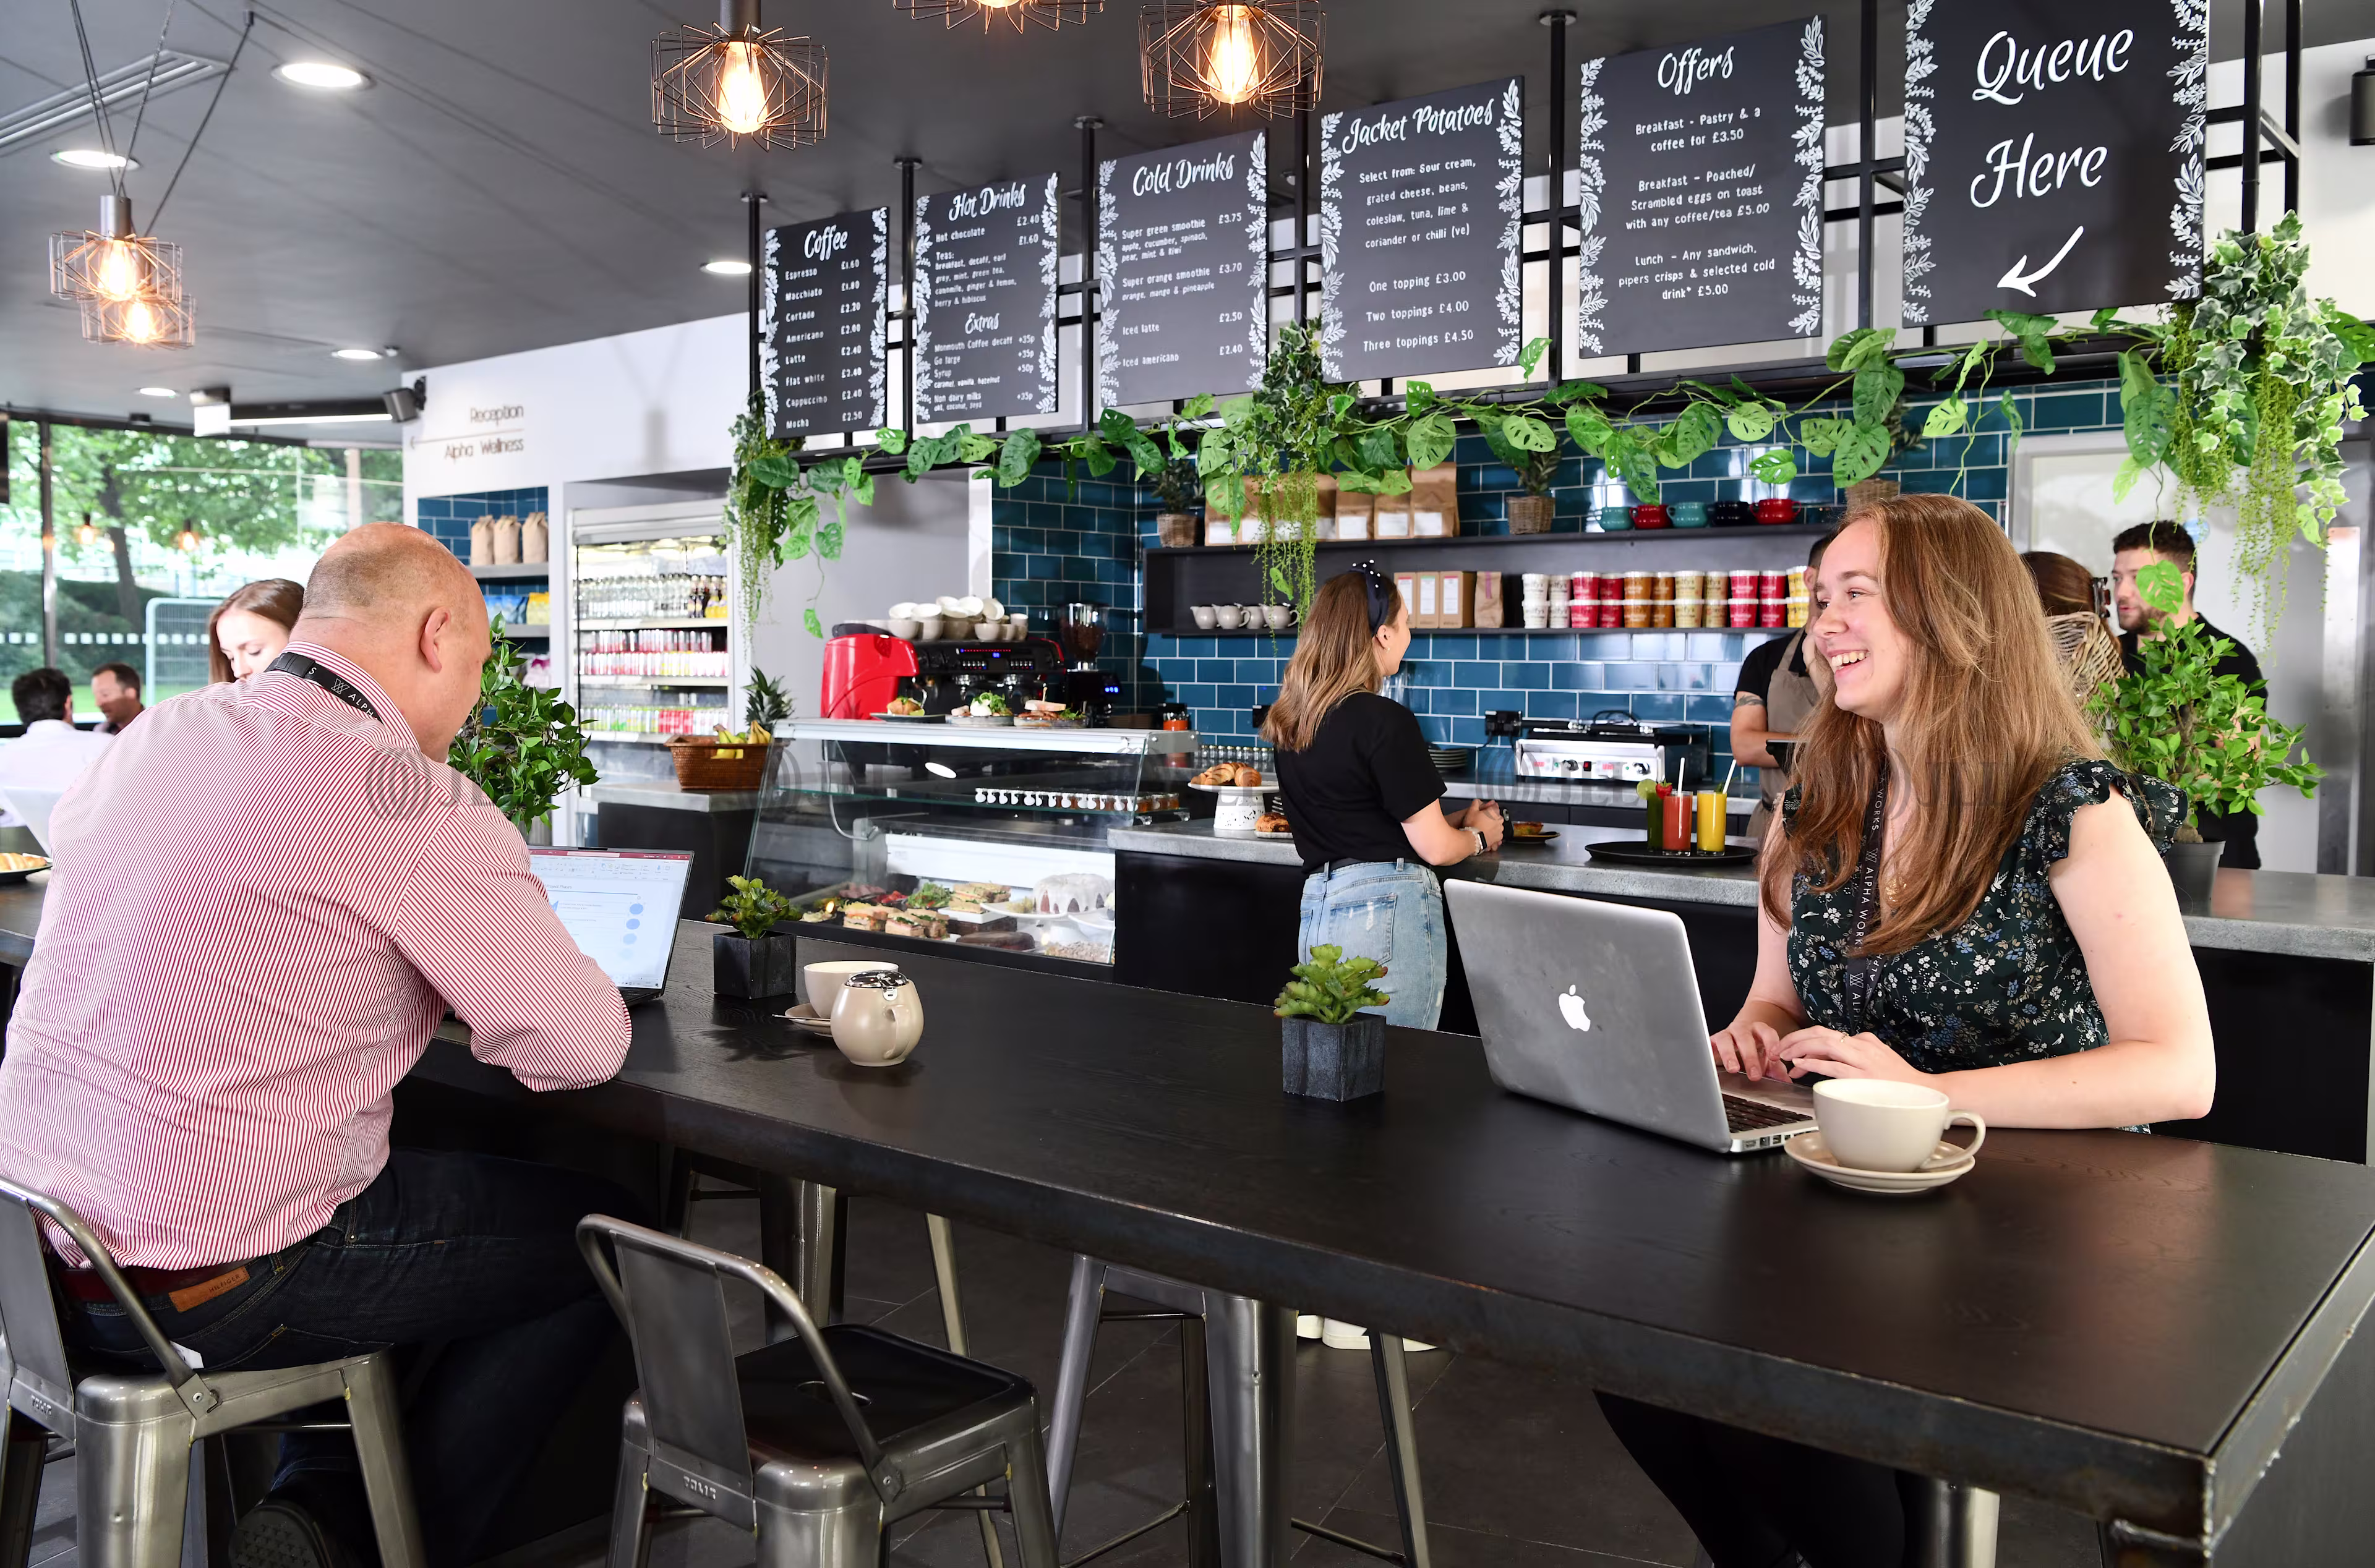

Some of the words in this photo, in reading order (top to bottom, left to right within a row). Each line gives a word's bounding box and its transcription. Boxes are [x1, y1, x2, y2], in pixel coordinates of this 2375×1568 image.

[1658, 46, 1734, 95] Offers
[1972, 30, 2133, 105] Queue
[1342, 114, 1407, 153] Jacket
[1413, 98, 1494, 135] Potatoes
[1636, 119, 1684, 135] Breakfast
[1700, 113, 1733, 125] Pastry
[1740, 108, 1748, 119] &
[1755, 108, 1760, 117] a
[1651, 139, 1684, 151] coffee
[1691, 136, 1705, 146] for
[1713, 129, 1744, 143] £3.50
[1133, 163, 1171, 196] Cold
[1176, 153, 1235, 189] Drinks
[1359, 171, 1387, 183] Select
[1392, 168, 1415, 178] from:
[1419, 163, 1440, 173] Sour
[1445, 159, 1475, 169] cream,
[1639, 176, 1687, 192] Breakfast
[1706, 164, 1755, 182] Poached/
[1971, 132, 2107, 207] Here
[949, 193, 977, 221] Hot
[980, 182, 1025, 215] Drinks
[1367, 191, 1395, 205] grated
[1400, 188, 1434, 199] cheese,
[1439, 182, 1468, 193] beans,
[1632, 195, 1682, 210] Scrambled
[1688, 192, 1711, 205] eggs
[1718, 190, 1730, 199] on
[1737, 185, 1763, 197] toast
[1366, 214, 1405, 226] coleslaw,
[1411, 210, 1432, 219] tuna,
[1438, 206, 1456, 216] lime
[1462, 203, 1468, 213] &
[1626, 218, 1646, 229] with
[1651, 218, 1669, 227] any
[1675, 210, 1732, 224] coffee/tea
[1737, 203, 1769, 216] £5.00
[936, 232, 948, 242] Hot
[951, 228, 985, 240] chocolate
[1017, 215, 1039, 226] £2.40
[1122, 229, 1142, 239] Super
[1147, 226, 1168, 236] green
[1172, 219, 1205, 231] smoothie
[1219, 213, 1241, 224] £3.75
[1366, 236, 1406, 248] coriander
[1426, 228, 1446, 240] chilli
[1452, 223, 1469, 238] (ve)
[805, 225, 847, 261] Coffee
[1019, 234, 1038, 245] £1.60
[1122, 242, 1141, 252] apple,
[1145, 238, 1177, 248] cucumber,
[1181, 232, 1207, 244] spinach,
[935, 260, 965, 270] breakfast,
[993, 254, 1006, 262] earl
[1121, 254, 1138, 263] pear,
[1142, 250, 1157, 259] mint
[1168, 246, 1181, 255] kiwi
[1636, 254, 1663, 265] Lunch
[1683, 250, 1701, 260] Any
[1708, 244, 1756, 257] sandwich,
[785, 268, 817, 280] Espresso
[841, 259, 859, 270] £1.60
[972, 270, 989, 278] green
[1123, 278, 1144, 288] Super
[1147, 273, 1172, 284] orange
[1176, 268, 1210, 279] smoothie
[1219, 263, 1242, 273] £3.70
[1619, 275, 1648, 288] pipers
[1655, 271, 1683, 282] crisps
[1690, 269, 1697, 278] &
[1703, 263, 1747, 277] selected
[1753, 258, 1774, 271] cold
[967, 283, 985, 291] ginger
[1123, 292, 1145, 300] orange,
[1150, 289, 1170, 297] mango
[1174, 286, 1178, 294] &
[1183, 282, 1214, 294] pineapple
[1369, 281, 1387, 292] One
[1393, 277, 1429, 289] topping
[1436, 271, 1466, 283] £3.00
[1698, 284, 1728, 296] £5.00
[785, 288, 822, 300] Macchiato
[786, 311, 815, 322] Cortado
[841, 302, 860, 313] £2.20
[1366, 312, 1385, 322] Two
[1392, 307, 1432, 319] toppings
[1440, 300, 1469, 313] £4.00
[965, 313, 999, 334] Extras
[1123, 326, 1138, 335] Iced
[1142, 324, 1159, 333] latte
[1220, 312, 1242, 322] £2.50
[786, 331, 823, 343] Americano
[935, 343, 965, 352] Monmouth
[967, 339, 988, 349] Coffee
[992, 336, 1012, 346] decaff
[1019, 334, 1035, 344] +35p
[1364, 341, 1390, 352] Three
[1397, 335, 1438, 348] toppings
[1445, 330, 1473, 343] £4.50
[785, 355, 805, 364] Latte
[841, 345, 861, 356] £2.40
[934, 357, 942, 365] Go
[945, 356, 960, 364] large
[1019, 349, 1034, 358] +35p
[1123, 358, 1138, 367] Iced
[1142, 354, 1179, 364] americano
[1220, 344, 1243, 355] £2.40
[805, 374, 824, 383] white
[842, 367, 862, 378] £2.40
[935, 369, 951, 378] Syrup
[1018, 364, 1033, 373] +50p
[978, 376, 1000, 385] hazelnut
[786, 396, 827, 407] Cappuccino
[842, 389, 862, 400] £2.40
[949, 394, 964, 403] dairy
[967, 392, 981, 400] milks
[1017, 392, 1033, 401] +35p
[470, 404, 524, 426] Reception
[786, 419, 808, 428] Mocha
[842, 411, 862, 421] £2.50
[444, 443, 474, 464] Alpha
[481, 438, 524, 455] Wellness
[348, 693, 374, 718] ALPH
[1871, 788, 1885, 831] WORKS
[1861, 867, 1875, 905] ALPHA
[1855, 910, 1868, 950] WORK
[208, 1274, 240, 1293] HILFIGER
